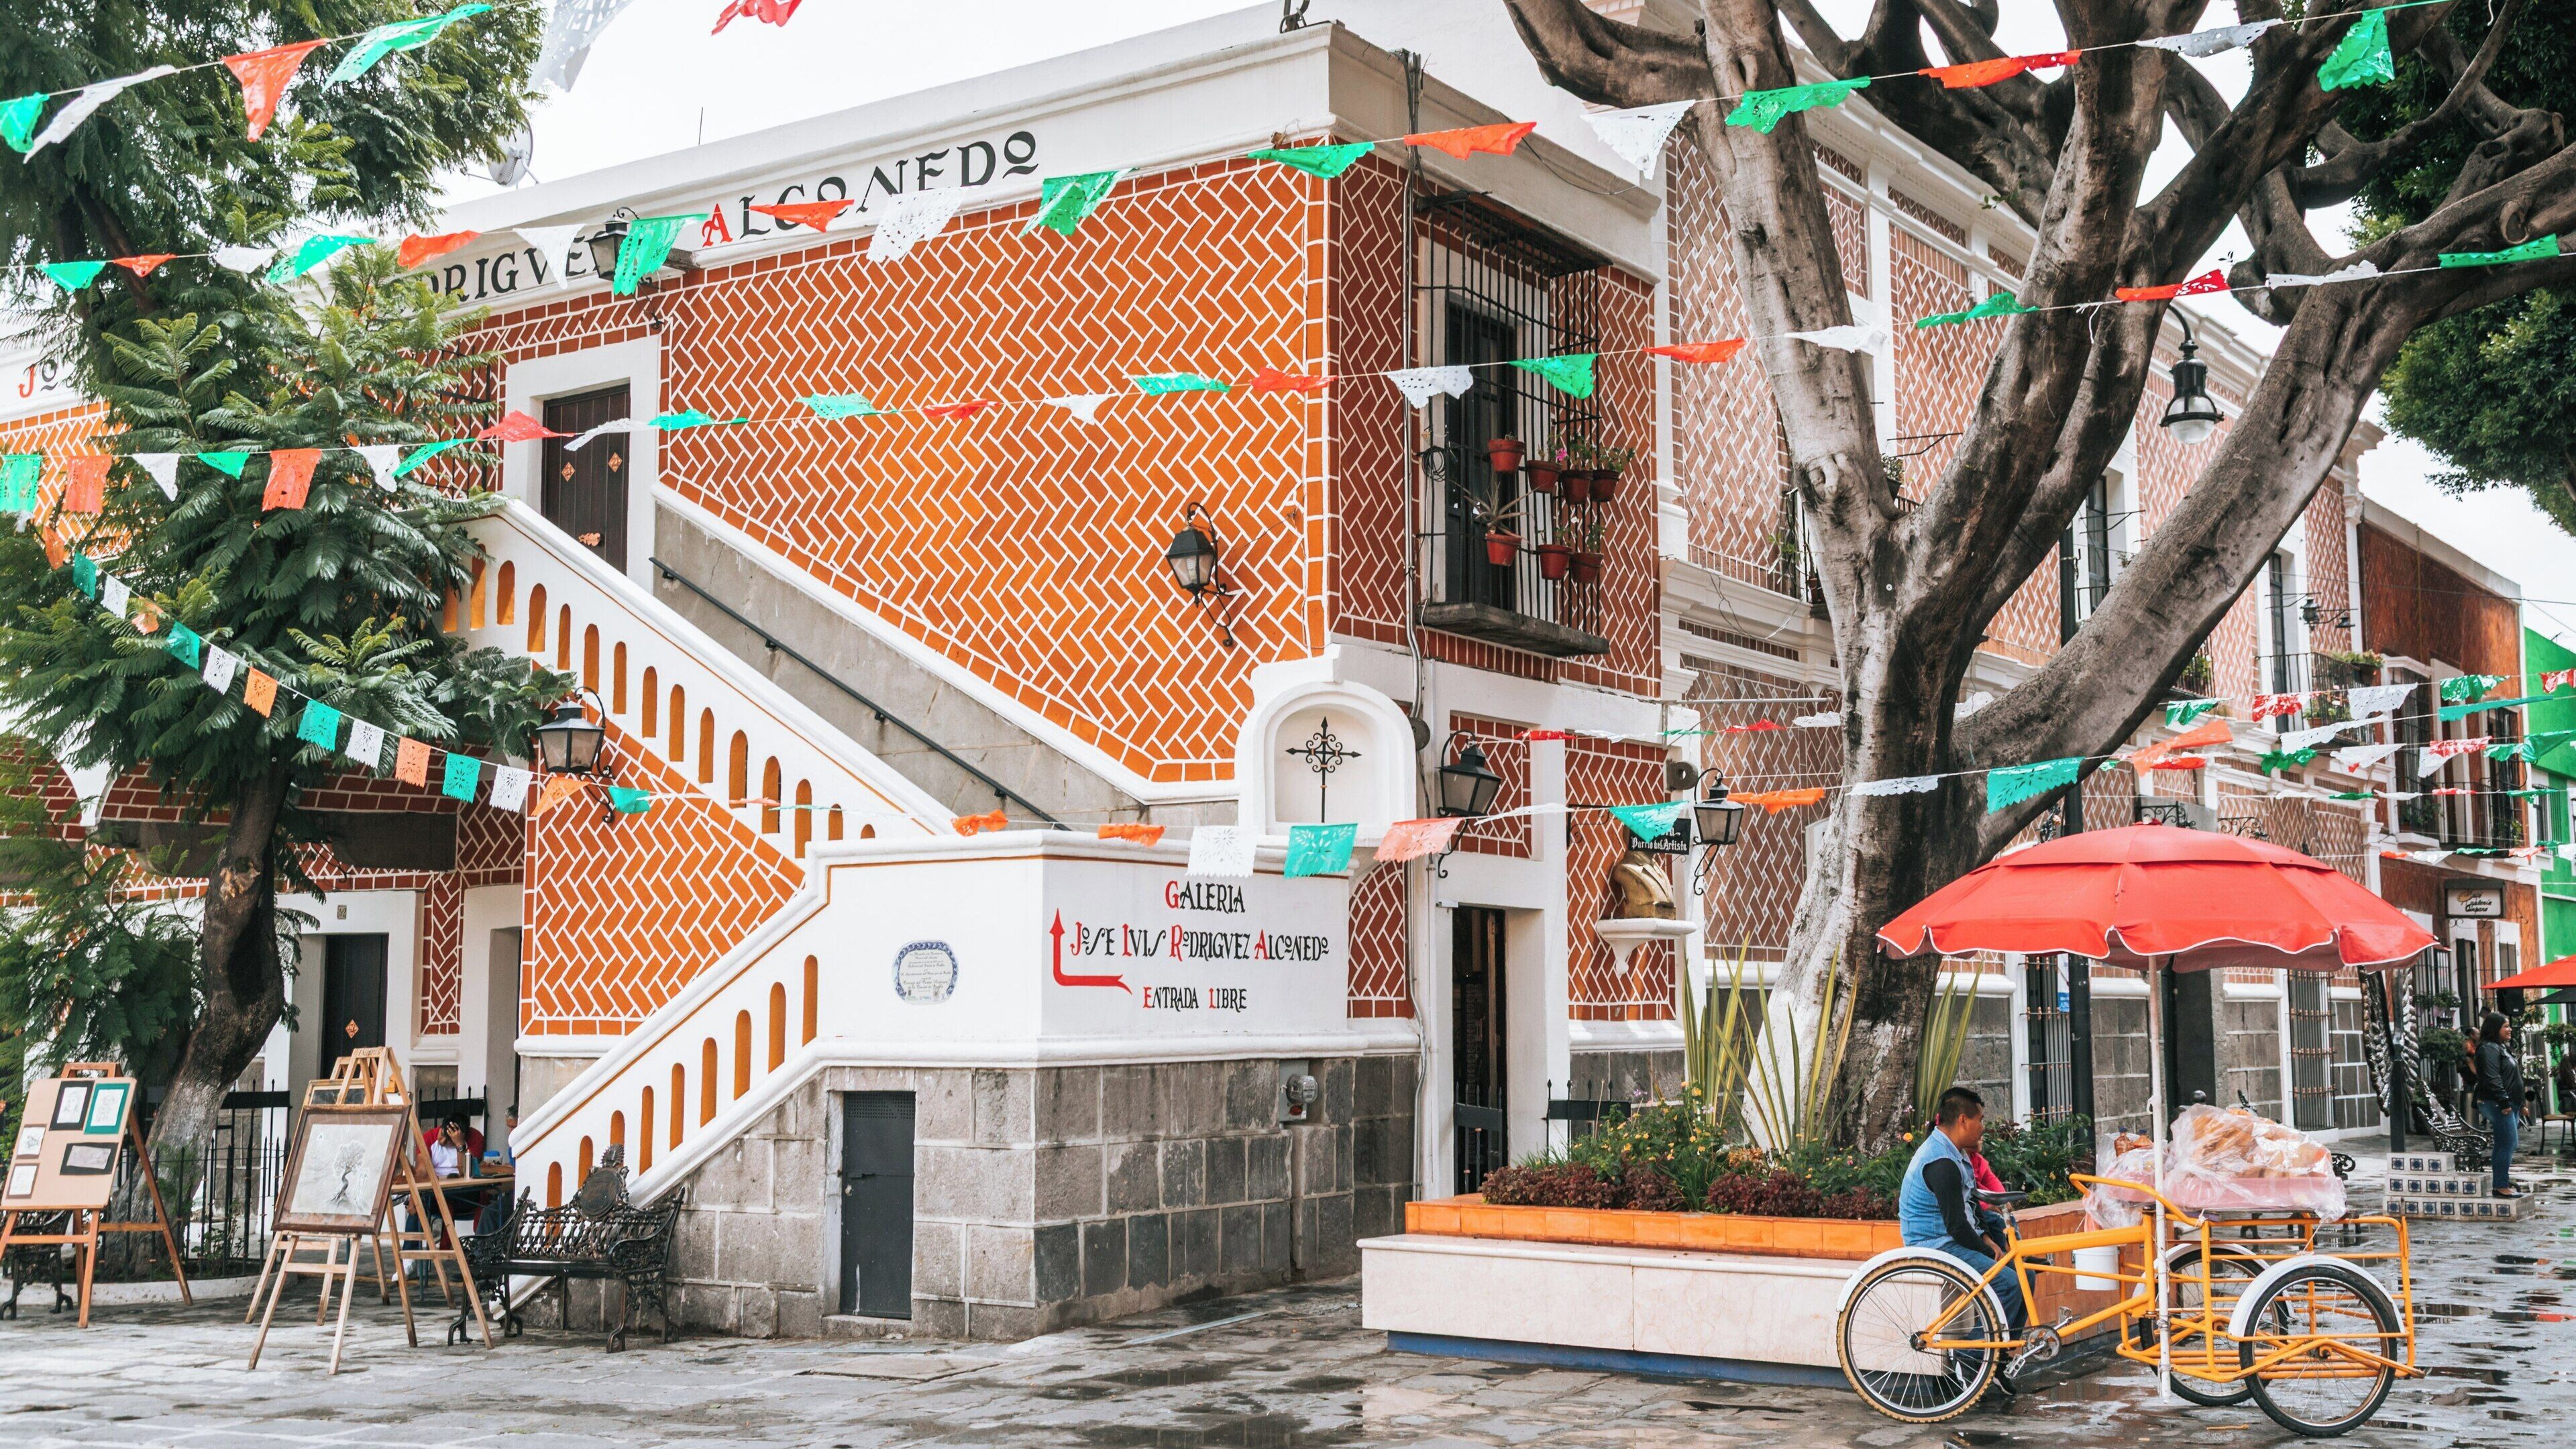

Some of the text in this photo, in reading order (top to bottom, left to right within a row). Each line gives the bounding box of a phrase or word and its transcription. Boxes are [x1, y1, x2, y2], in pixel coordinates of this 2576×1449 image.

[702, 131, 1039, 248] ALCONEDO
[1165, 881, 1245, 914] GALERIA
[1143, 987, 1246, 1012] ENTRADA LIBRE
